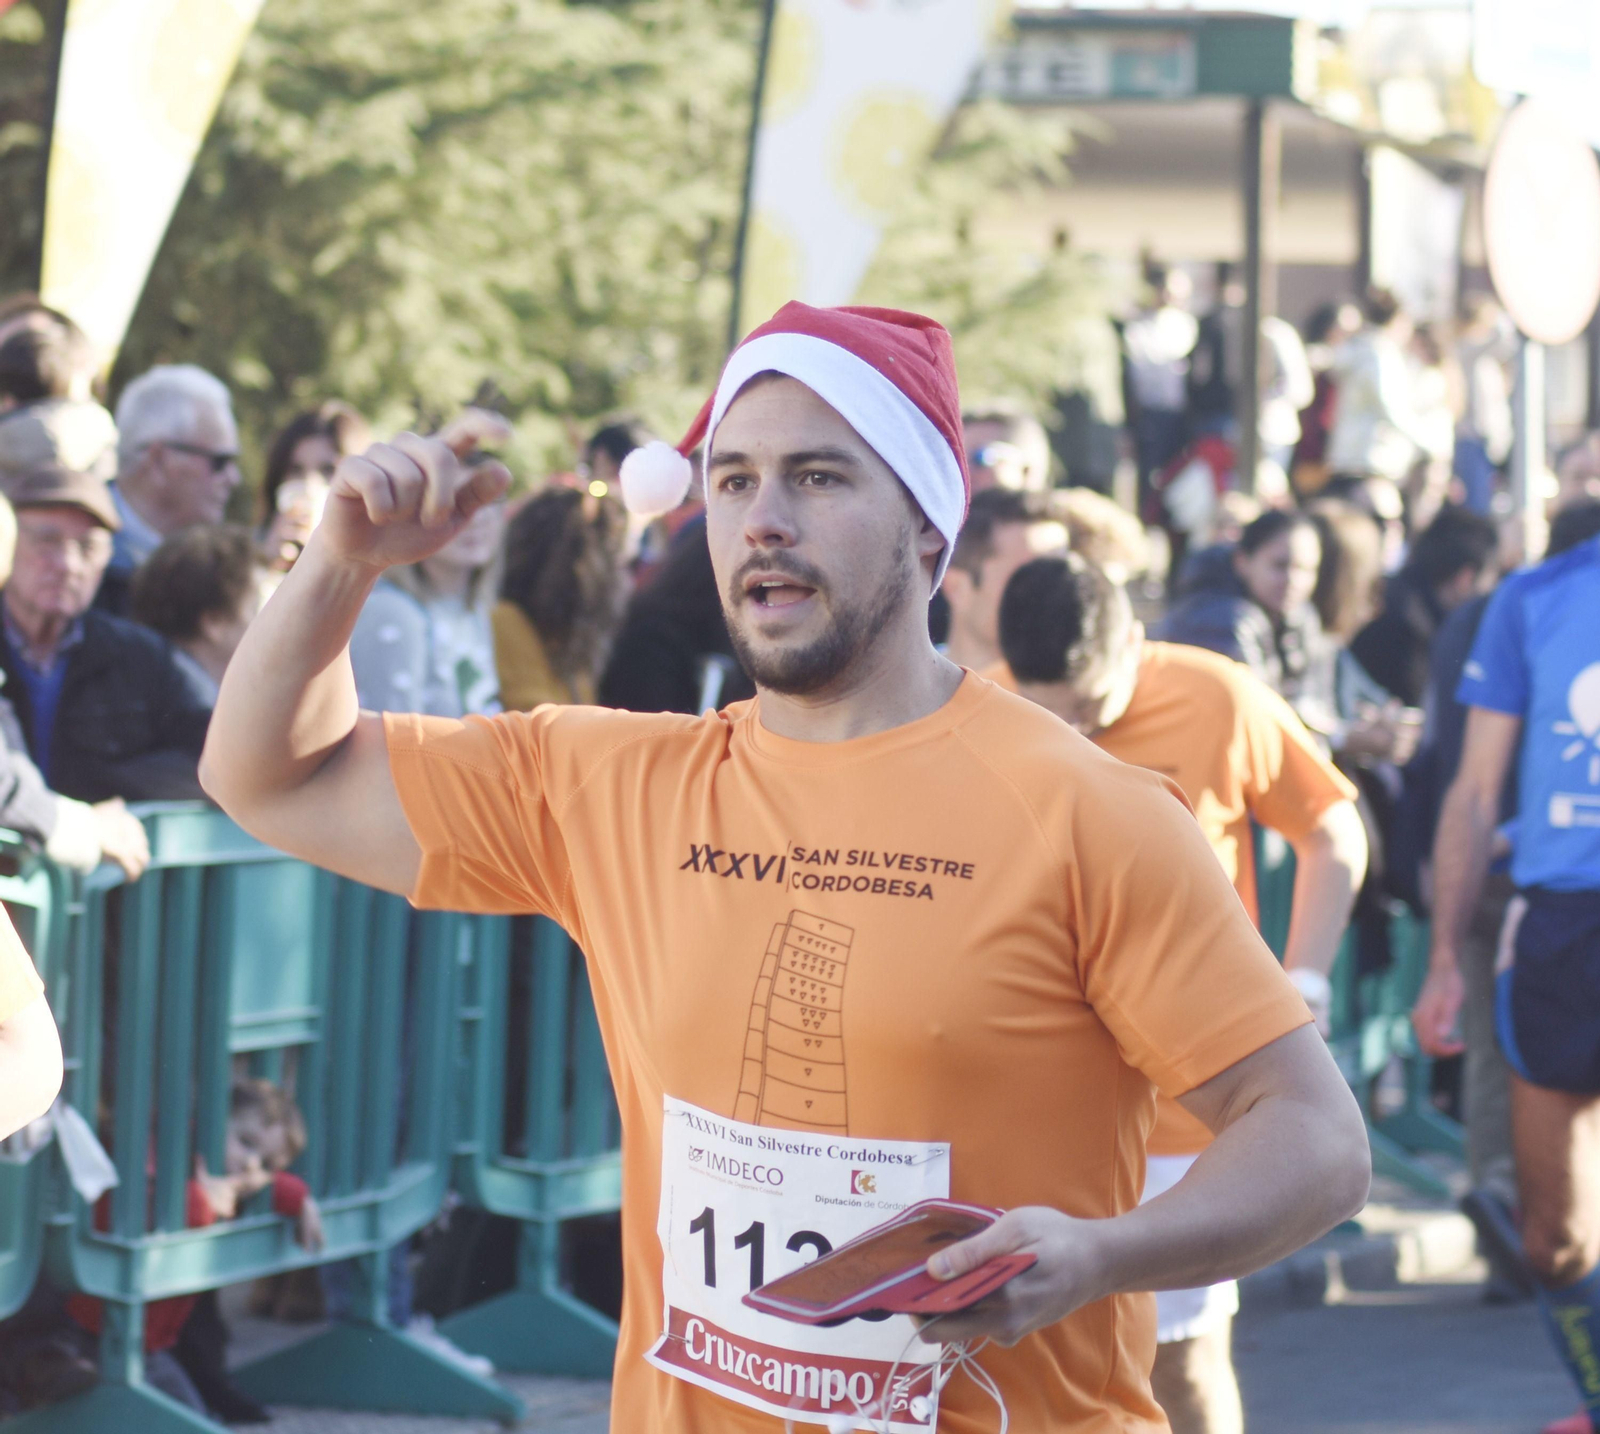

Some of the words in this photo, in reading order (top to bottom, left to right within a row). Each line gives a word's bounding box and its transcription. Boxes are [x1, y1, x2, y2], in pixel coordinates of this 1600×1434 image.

[679, 843, 787, 884] XXXVI
[791, 846, 839, 865] SAN
[846, 849, 975, 880] SILVESTRE
[792, 871, 934, 901] CORDOBESA
[686, 1112, 725, 1140] XXXVI
[729, 1129, 753, 1147] San
[758, 1135, 822, 1156] Silvestre
[827, 1145, 913, 1165] Cordobesa
[707, 1150, 784, 1186] IMDECO
[815, 1195, 862, 1208] Diputación
[864, 1200, 875, 1209] de
[877, 1200, 911, 1213] Córdob
[684, 1318, 874, 1409] Cruzcampo
[892, 1375, 911, 1410] SIN
